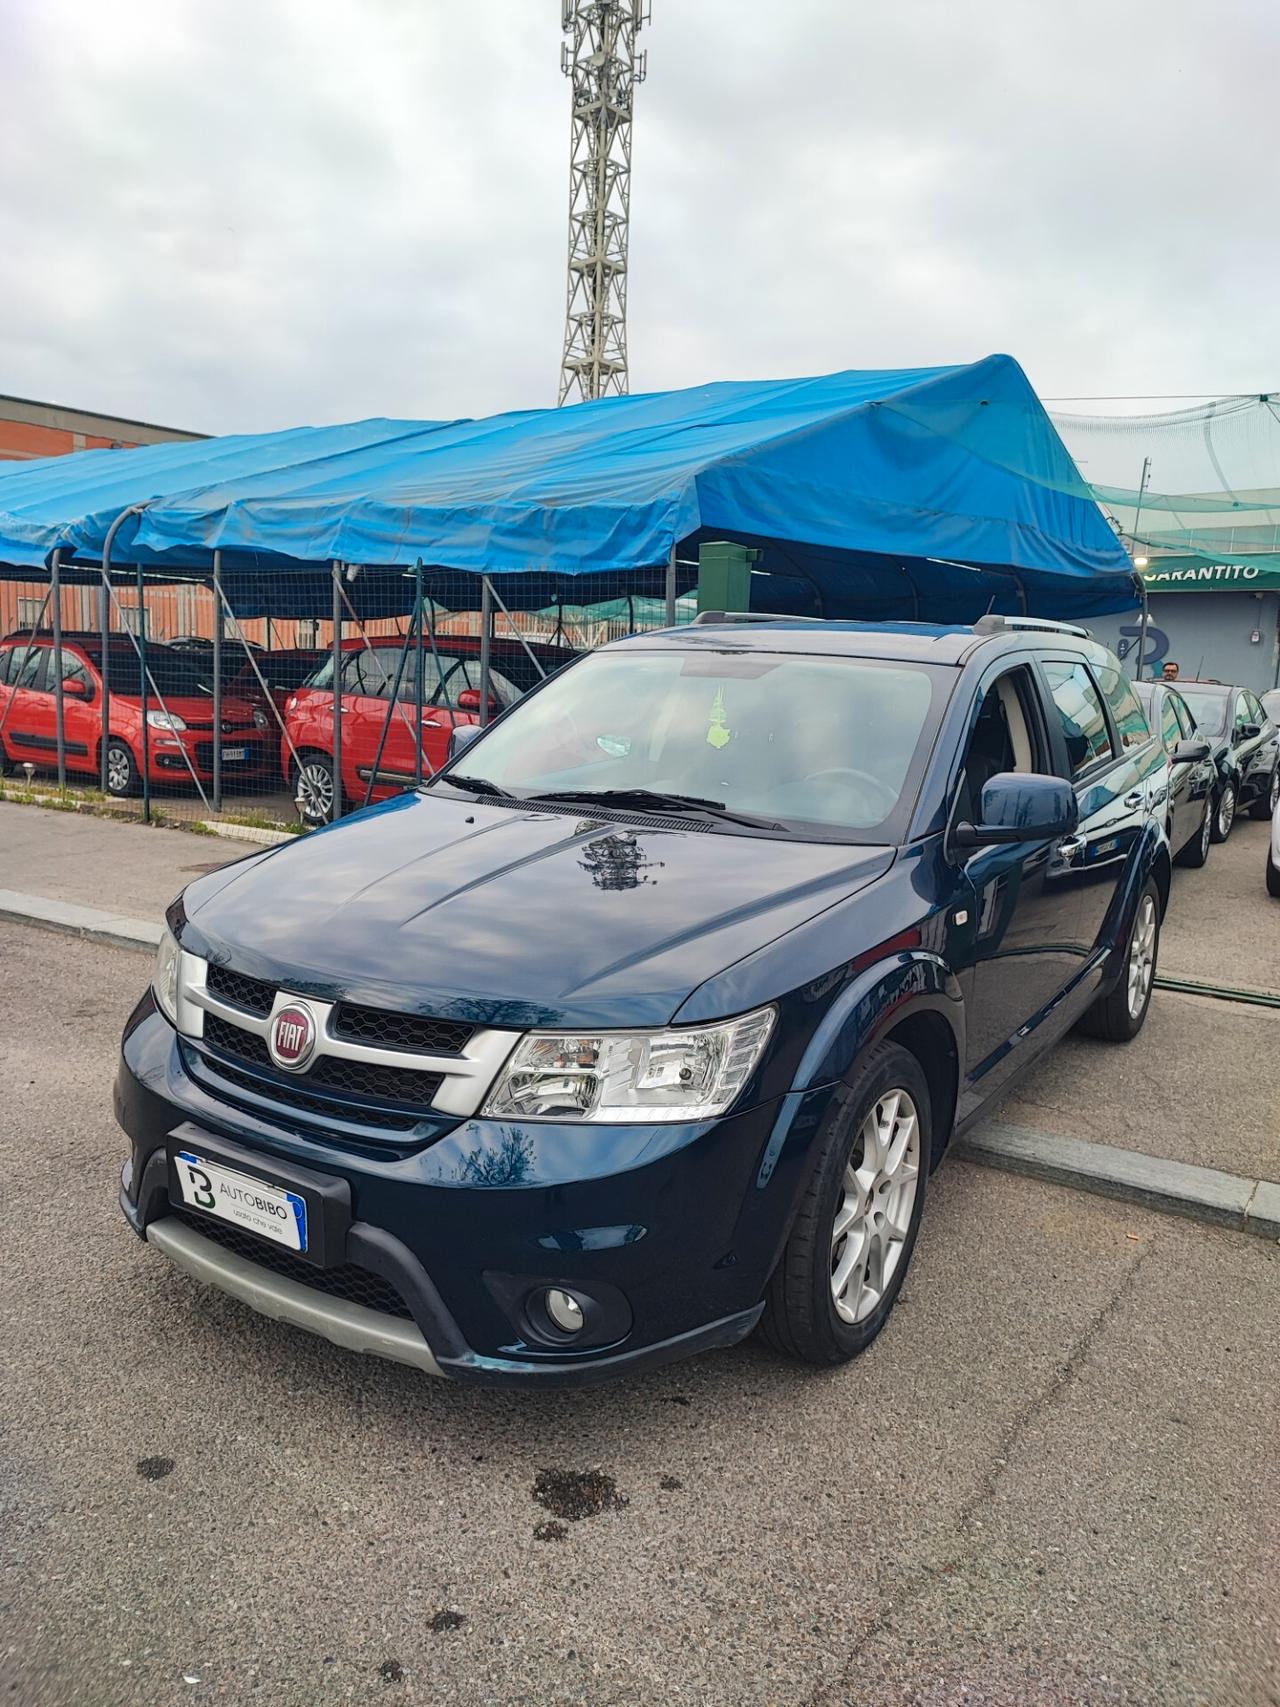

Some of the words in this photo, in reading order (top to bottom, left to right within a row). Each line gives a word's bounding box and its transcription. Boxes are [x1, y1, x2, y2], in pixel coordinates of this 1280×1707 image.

[277, 1021, 305, 1051] FIAT
[219, 1183, 288, 1220] AUTOBIBO
[233, 1209, 252, 1222] usato
[252, 1216, 267, 1229] che
[267, 1223, 283, 1235] vale
